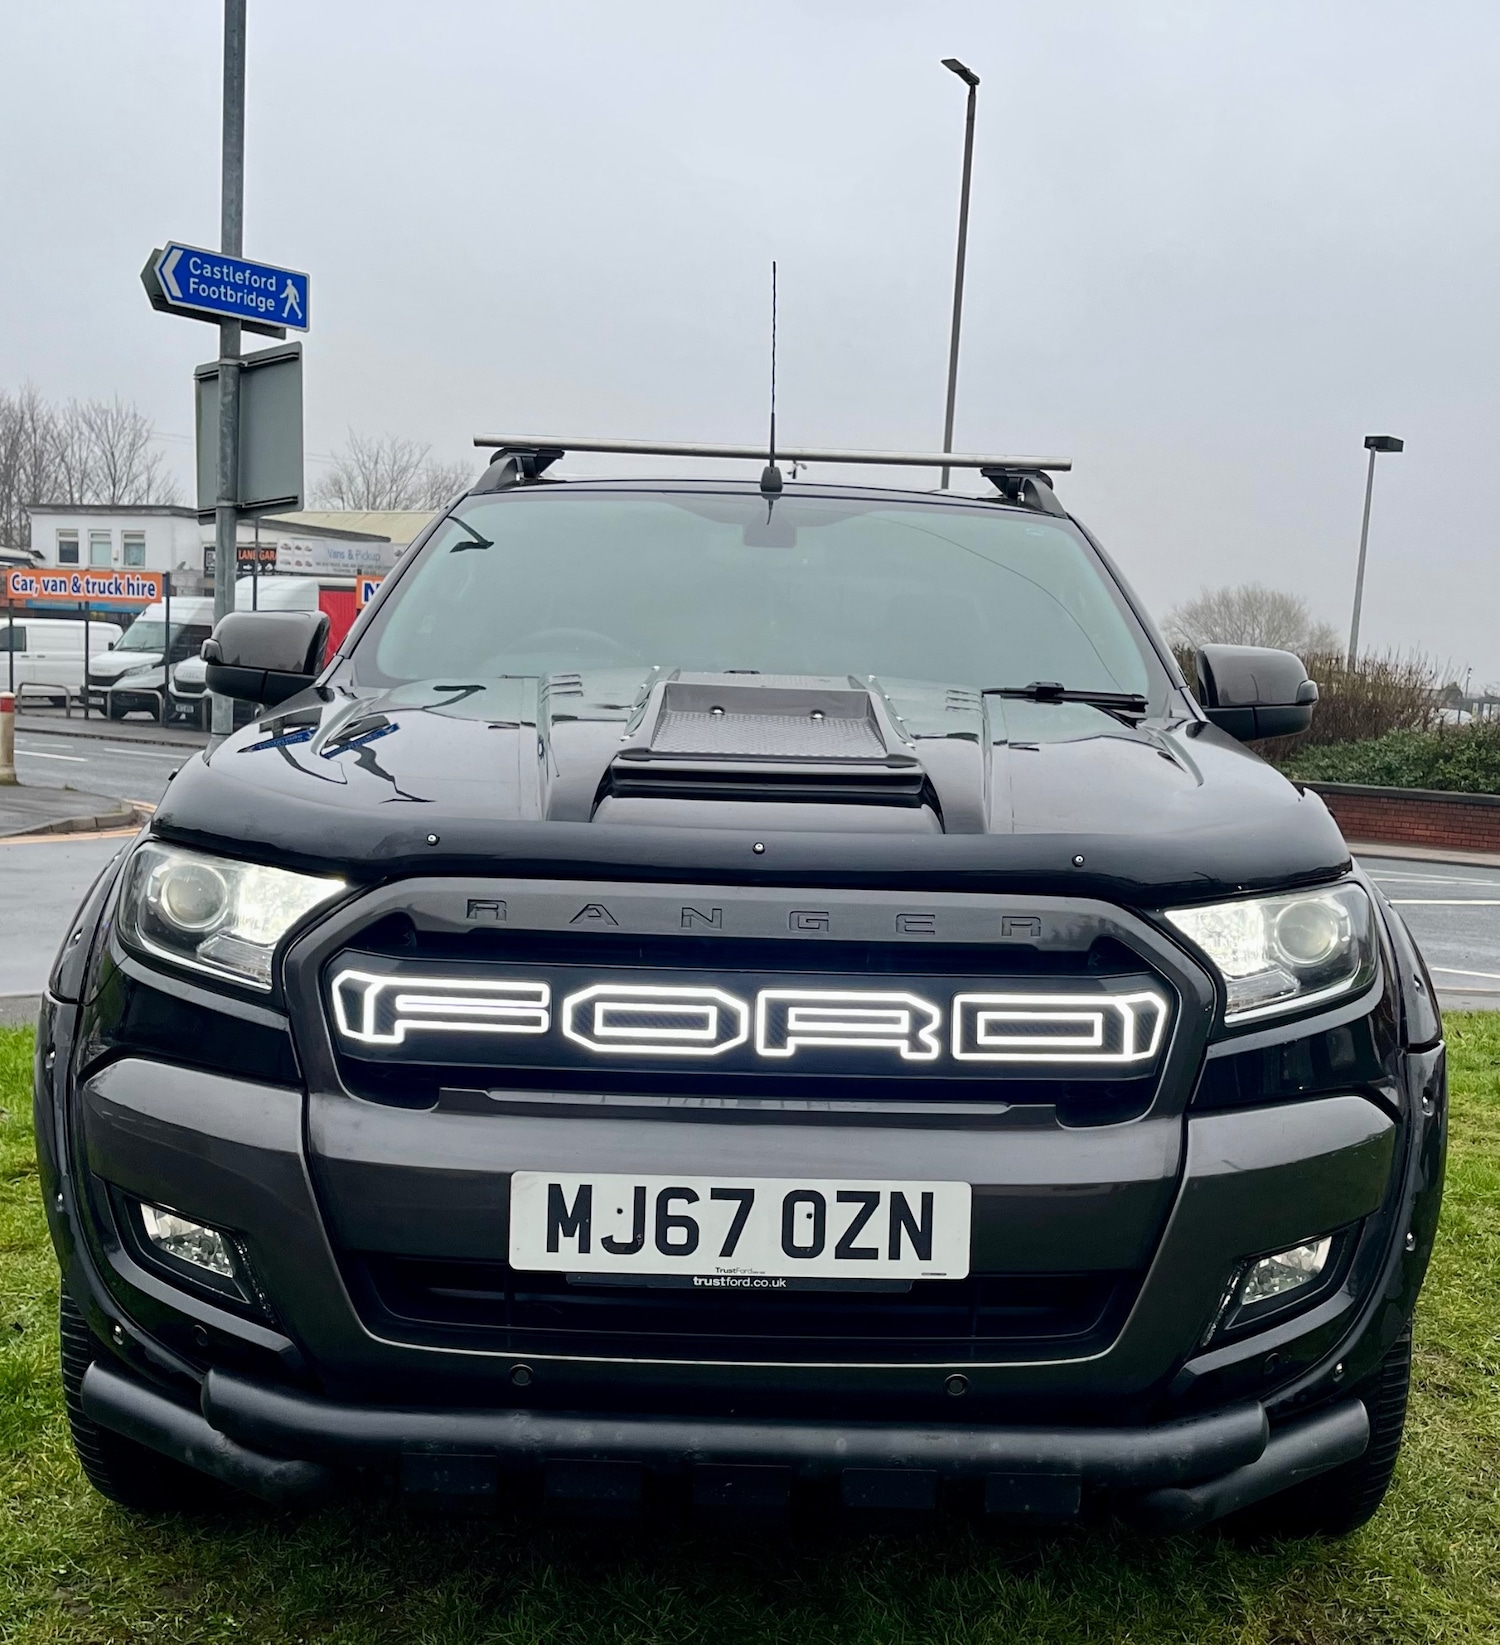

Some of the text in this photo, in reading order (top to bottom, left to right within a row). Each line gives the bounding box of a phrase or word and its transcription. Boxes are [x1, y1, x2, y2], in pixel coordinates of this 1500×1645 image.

[189, 257, 276, 291] Castleford
[189, 278, 275, 312] Footbridge
[259, 550, 276, 560] GAR
[328, 548, 381, 563] Vans & Pickup
[11, 574, 156, 597] Car, van & truck hire
[466, 898, 1042, 938] RANGER
[331, 968, 1168, 1063] FORD
[546, 1183, 755, 1258] MJ67
[693, 1276, 787, 1289] trustford.co.uk
[715, 1266, 753, 1275] TrustFord
